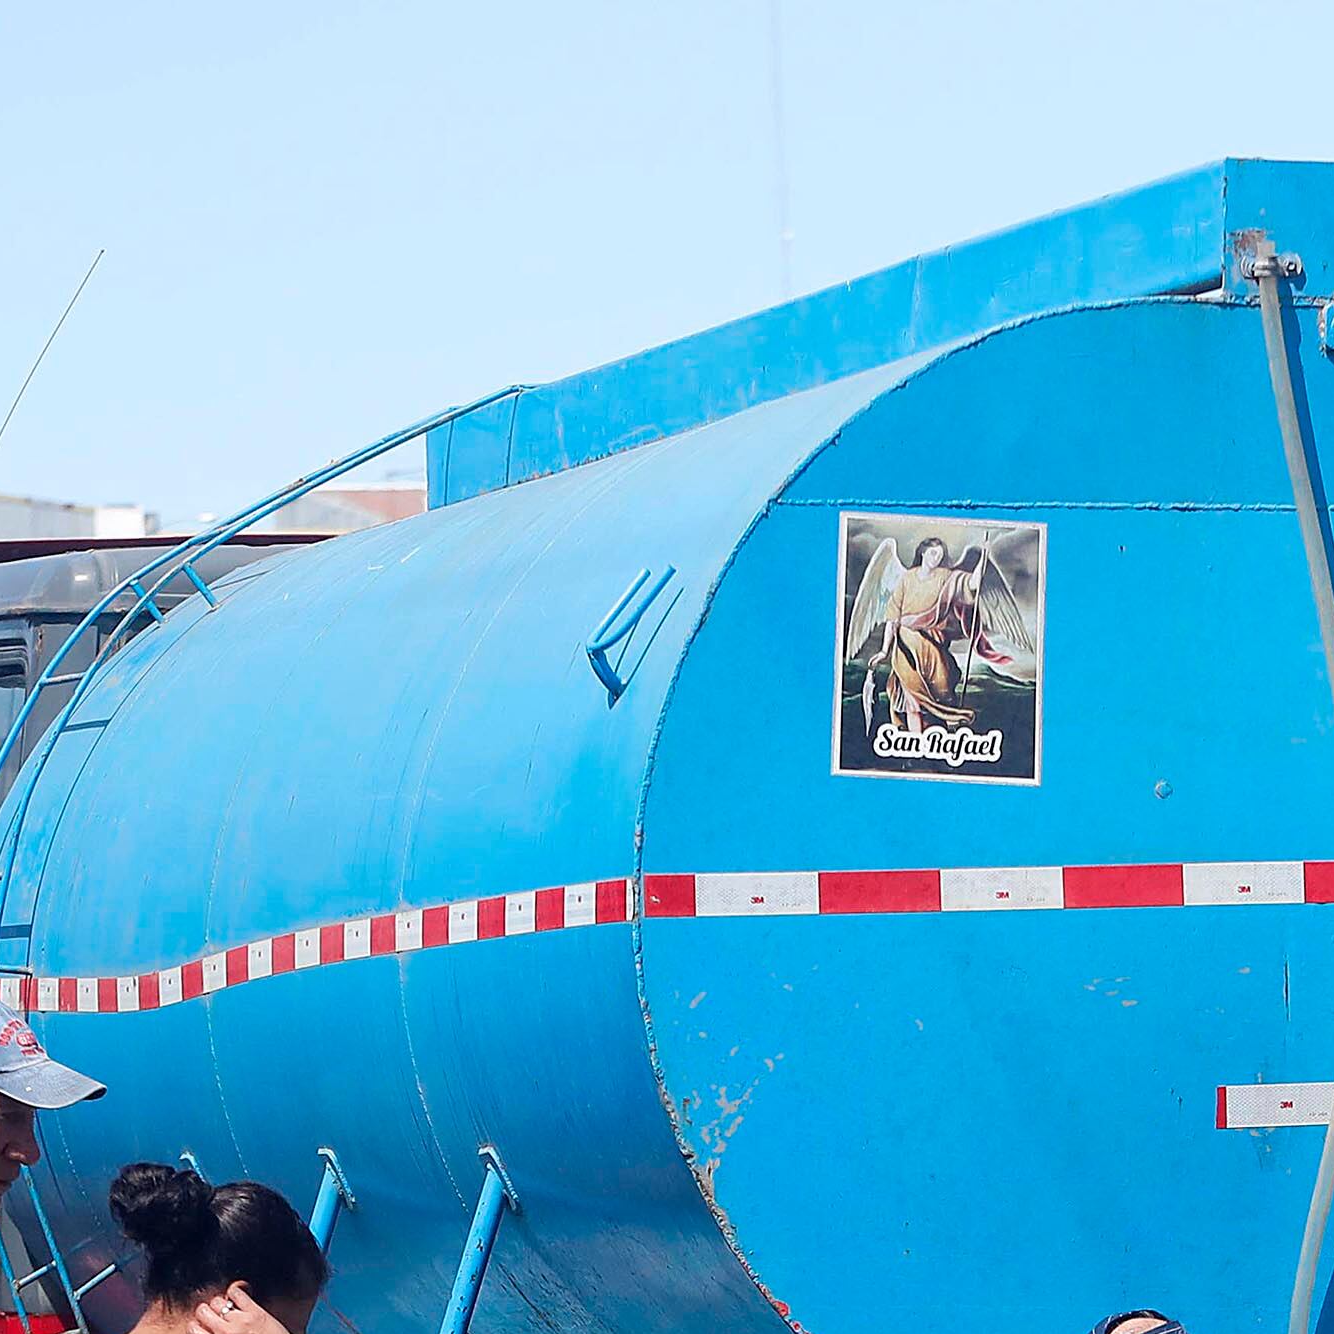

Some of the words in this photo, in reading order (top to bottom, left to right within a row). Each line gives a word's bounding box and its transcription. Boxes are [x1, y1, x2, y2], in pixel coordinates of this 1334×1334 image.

[878, 728, 921, 752] San
[926, 731, 997, 761] Rafael
[1237, 885, 1251, 893] 3M
[750, 895, 765, 904] 3M
[995, 891, 1010, 899] 3M
[1280, 1100, 1294, 1109] 3M
